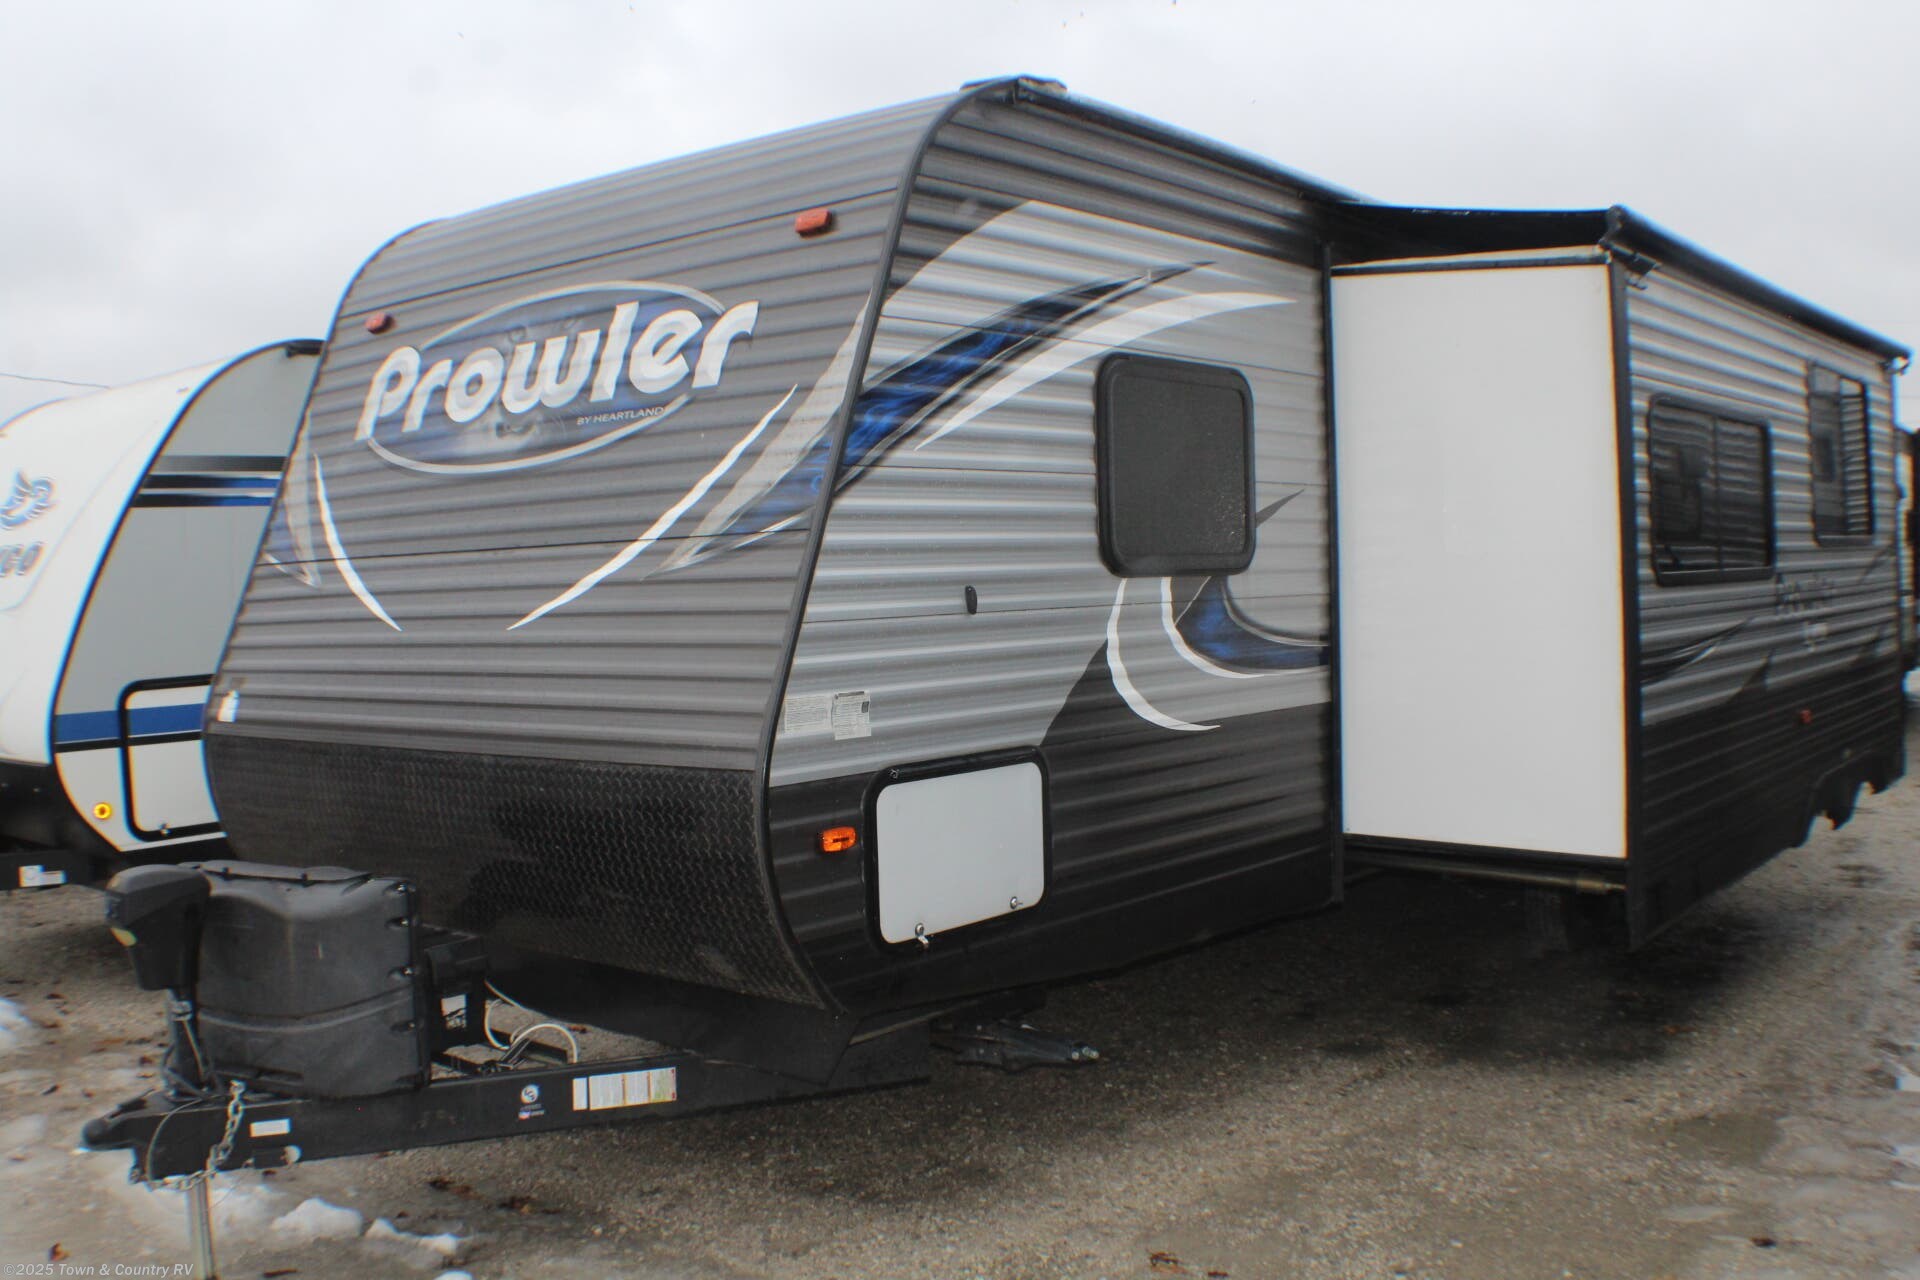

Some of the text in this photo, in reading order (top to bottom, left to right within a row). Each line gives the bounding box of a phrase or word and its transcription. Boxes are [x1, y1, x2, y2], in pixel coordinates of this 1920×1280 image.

[354, 301, 759, 441] Prowler
[577, 406, 664, 425] BY HEARTLAND
